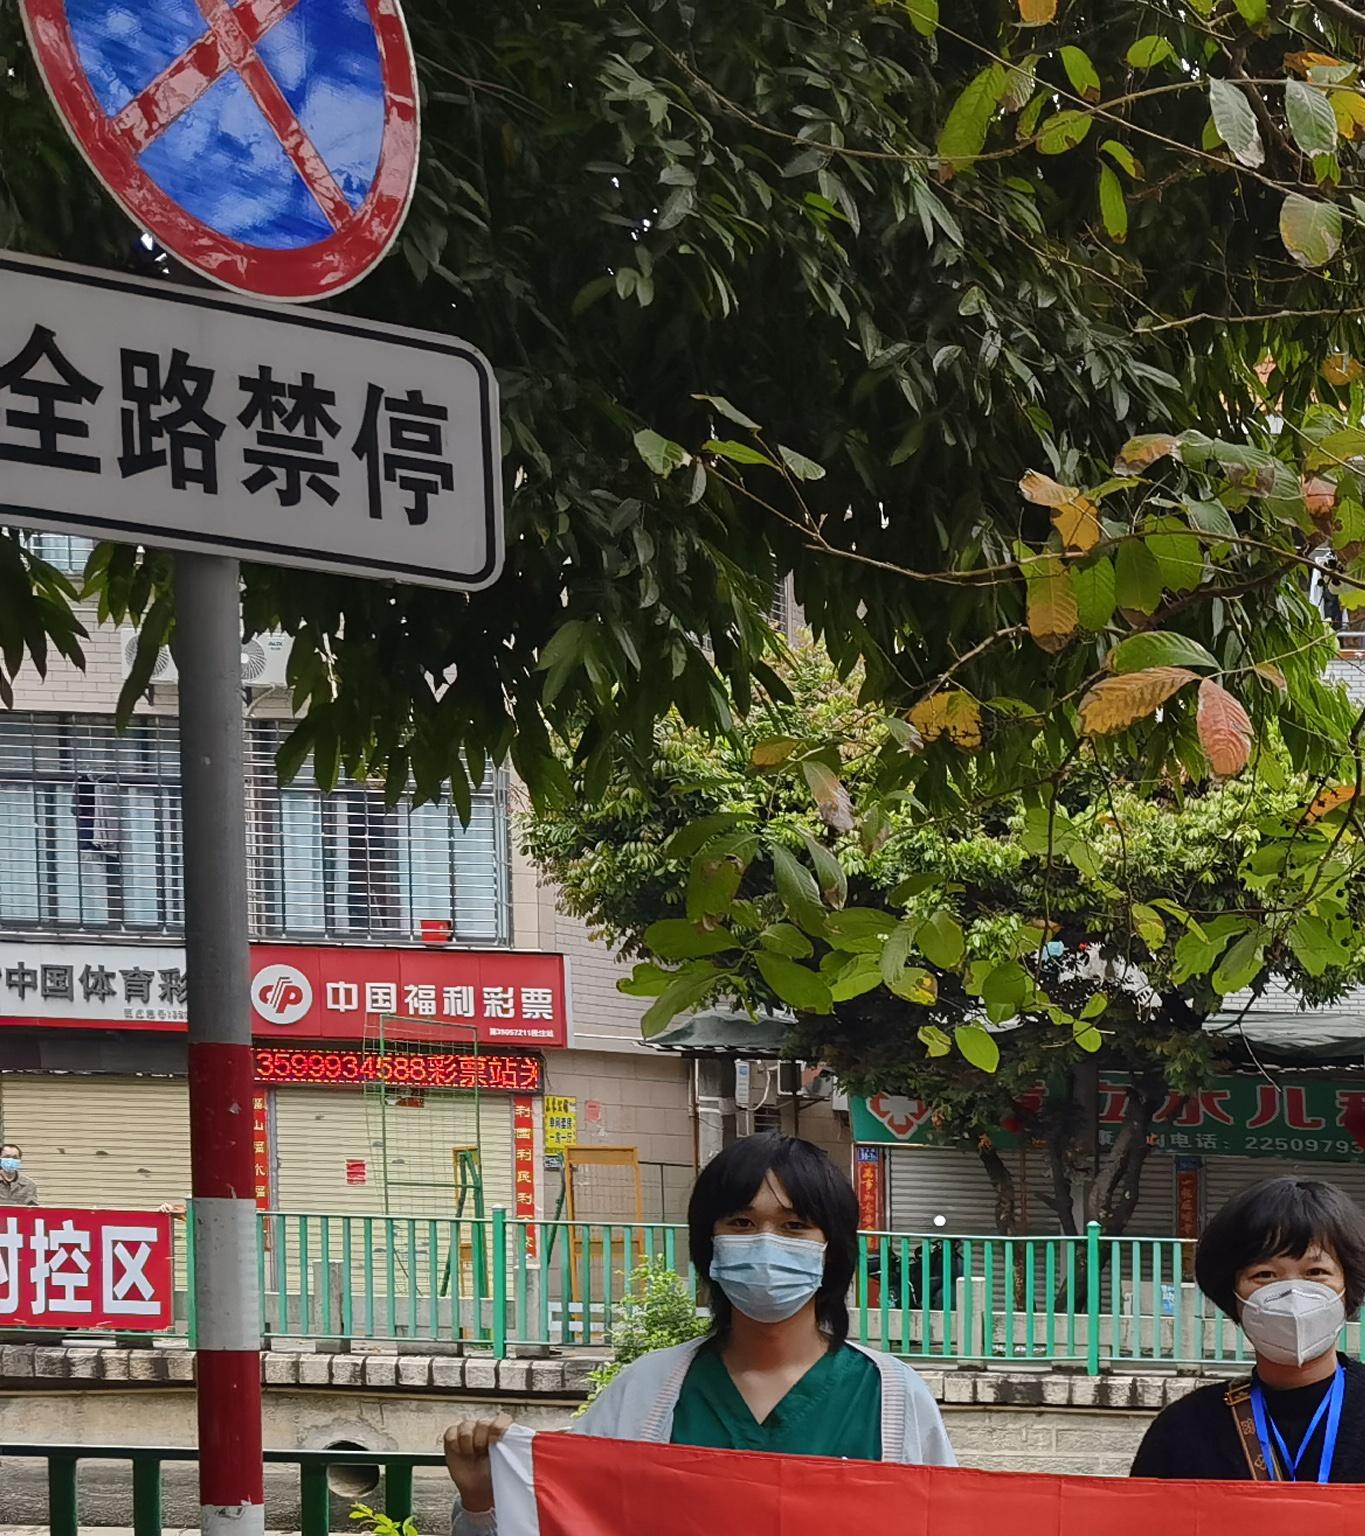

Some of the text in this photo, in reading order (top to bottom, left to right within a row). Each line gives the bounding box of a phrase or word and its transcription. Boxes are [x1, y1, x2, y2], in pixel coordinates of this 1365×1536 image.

[0, 323, 455, 526] 全路禁停
[326, 981, 553, 1020] 中国福利彩票
